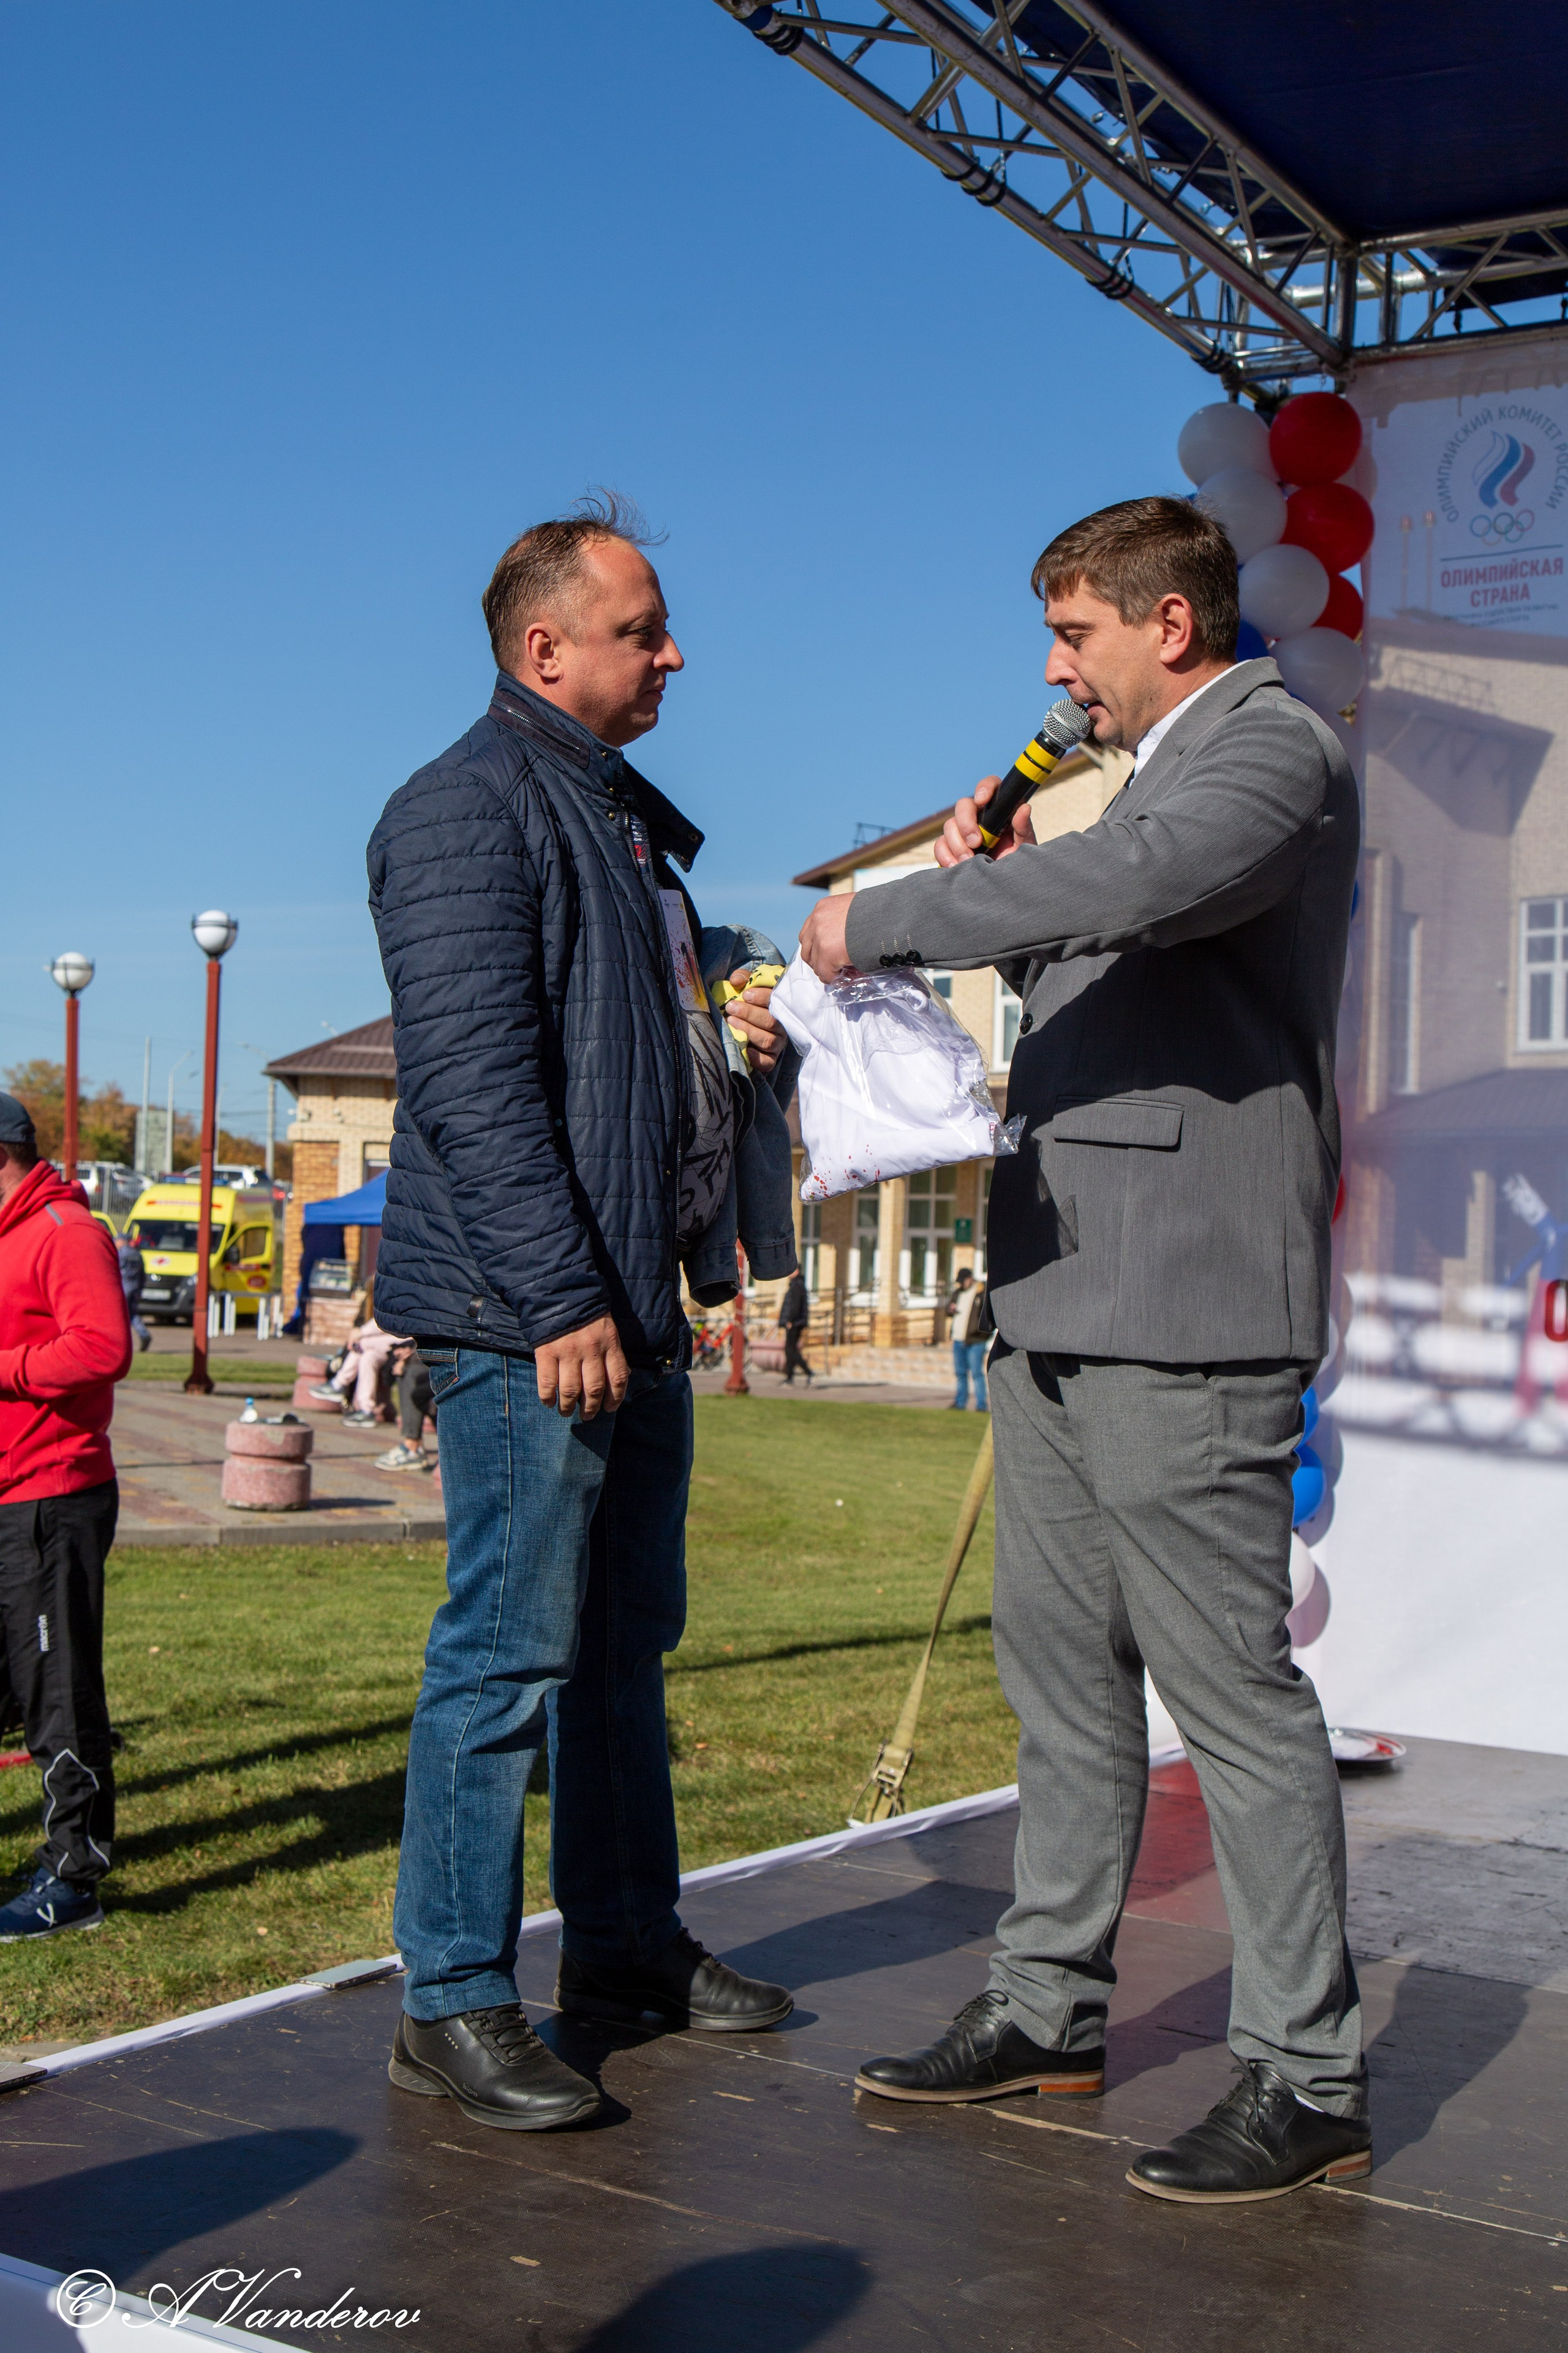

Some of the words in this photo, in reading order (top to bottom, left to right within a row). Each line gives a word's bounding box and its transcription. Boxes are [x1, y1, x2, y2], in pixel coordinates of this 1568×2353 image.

[1438, 407, 1493, 523] ОЛИМПИЙСКИЙ
[1498, 404, 1562, 441] КОМИТЕТ
[1545, 442, 1568, 510] РОССИИ
[1441, 557, 1564, 588] ОЛИМПИЙСКАЯ
[1471, 582, 1531, 608] СТРАНА
